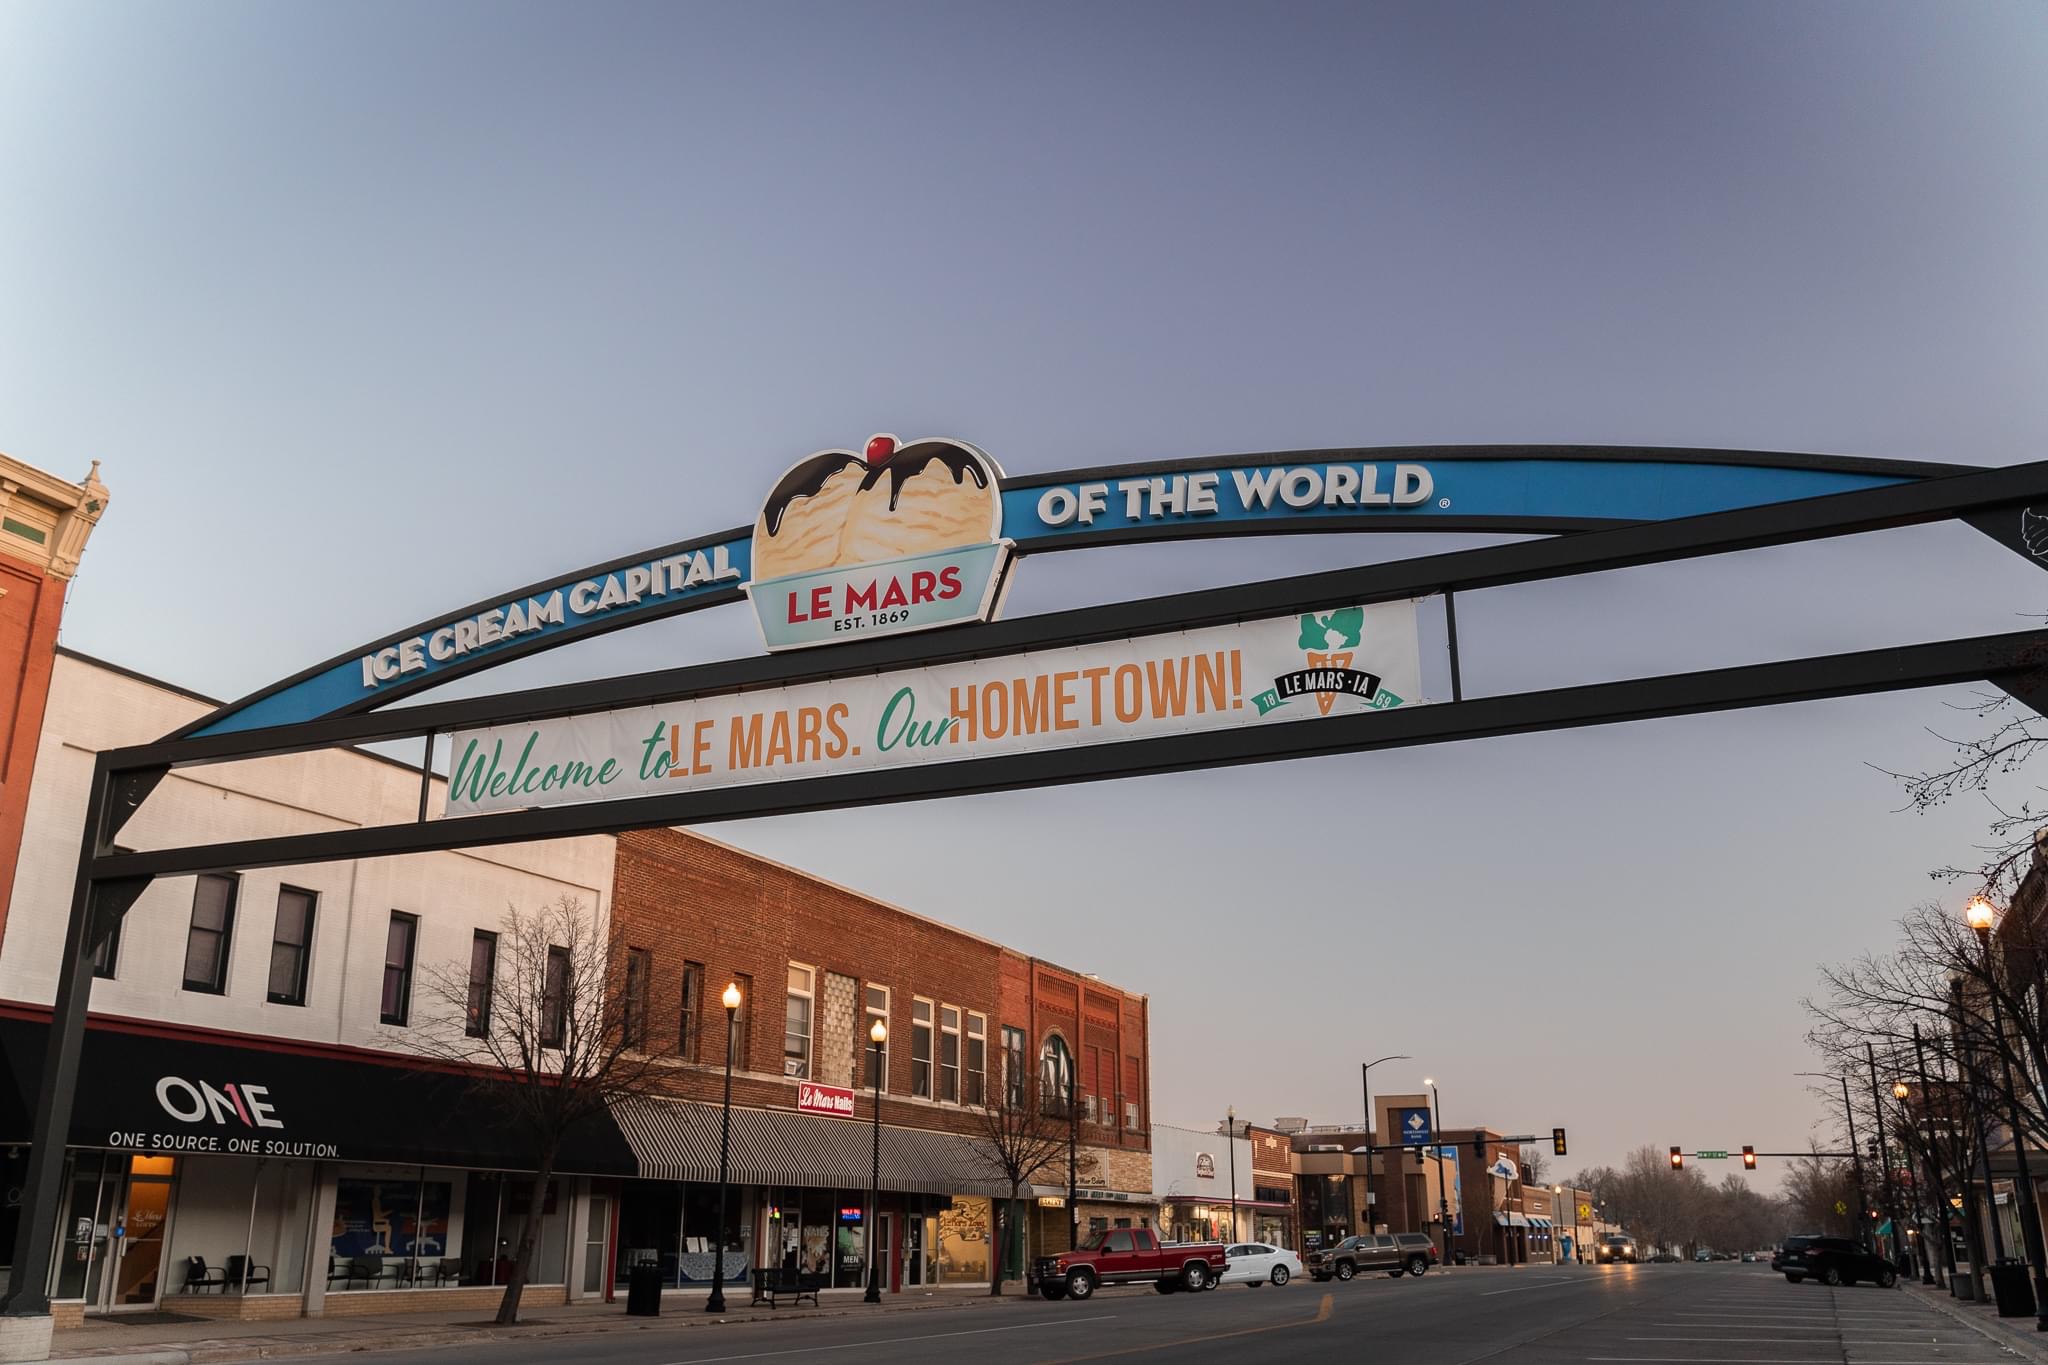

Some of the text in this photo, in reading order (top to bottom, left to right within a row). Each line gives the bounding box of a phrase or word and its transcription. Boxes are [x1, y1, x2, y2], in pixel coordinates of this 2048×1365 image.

[1037, 482, 1108, 526] OF
[1119, 472, 1219, 520] THE
[1231, 463, 1434, 511] WORLD
[788, 566, 962, 624] LE MARS
[361, 546, 741, 688] ICE CREAM CAPITAL
[834, 610, 909, 632] EST. 1869
[1284, 671, 1369, 695] LE MARS IA
[1263, 693, 1276, 708] 18
[1376, 693, 1392, 708] 69
[450, 649, 1243, 802] Welcome to LE MARS. Our HOMETOWN!
[800, 1086, 853, 1111] Le Mars Nails
[109, 1131, 340, 1158] ONE SOURCE. ONE SOLUTION.
[843, 1255, 859, 1264] MEN
